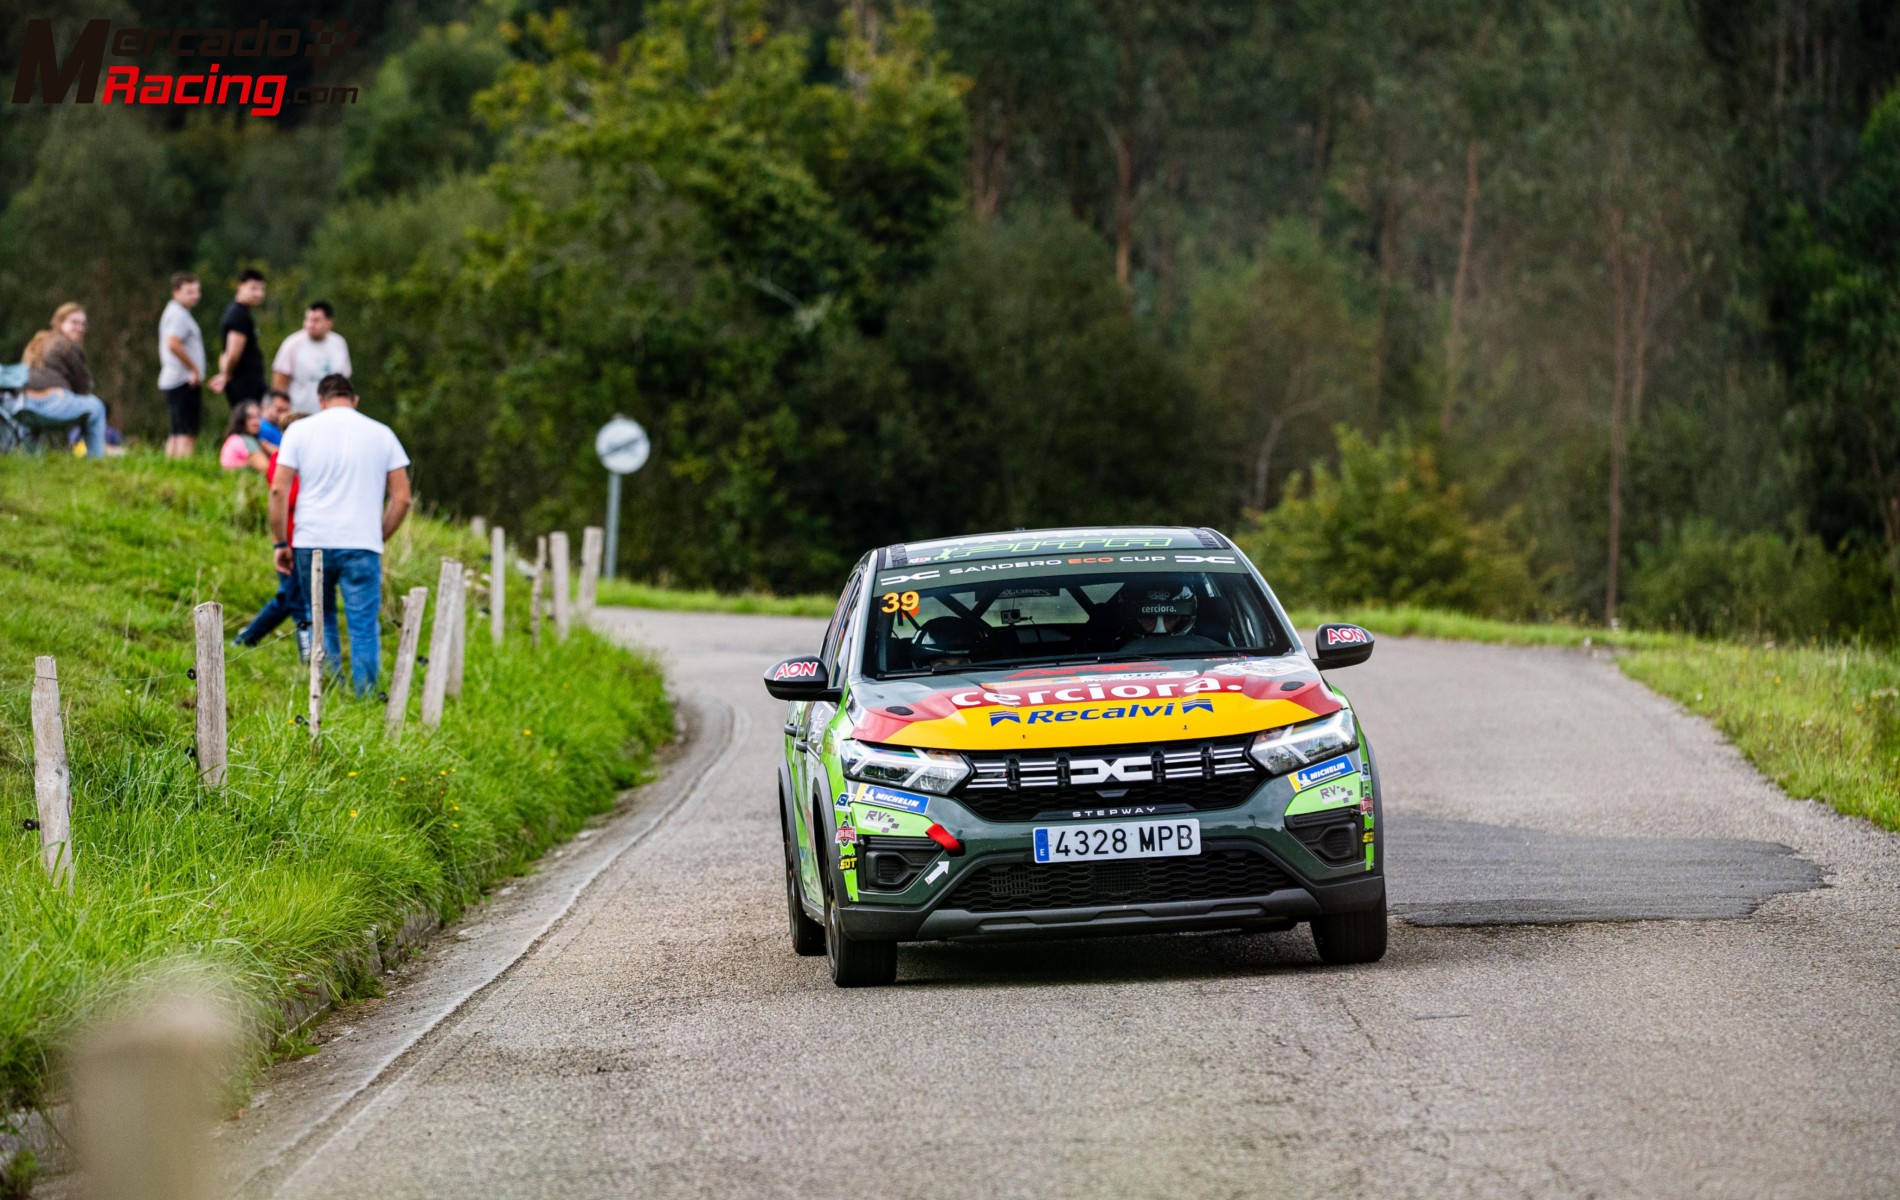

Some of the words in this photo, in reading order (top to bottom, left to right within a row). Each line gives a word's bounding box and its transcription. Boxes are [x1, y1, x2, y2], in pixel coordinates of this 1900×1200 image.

[948, 559, 1062, 575] SANDERO
[1067, 556, 1114, 565] ECO
[1119, 555, 1166, 563] CUP
[881, 590, 920, 614] 39
[1328, 628, 1368, 645] AON
[774, 662, 819, 681] AON
[1027, 702, 1176, 725] Recalvi
[1309, 762, 1346, 780] MICHELIN
[875, 793, 920, 807] MICHELIN
[1072, 806, 1157, 818] STEPWAY
[1039, 848, 1045, 857] E
[1055, 828, 1128, 857] 4328
[1139, 824, 1194, 853] MPB
